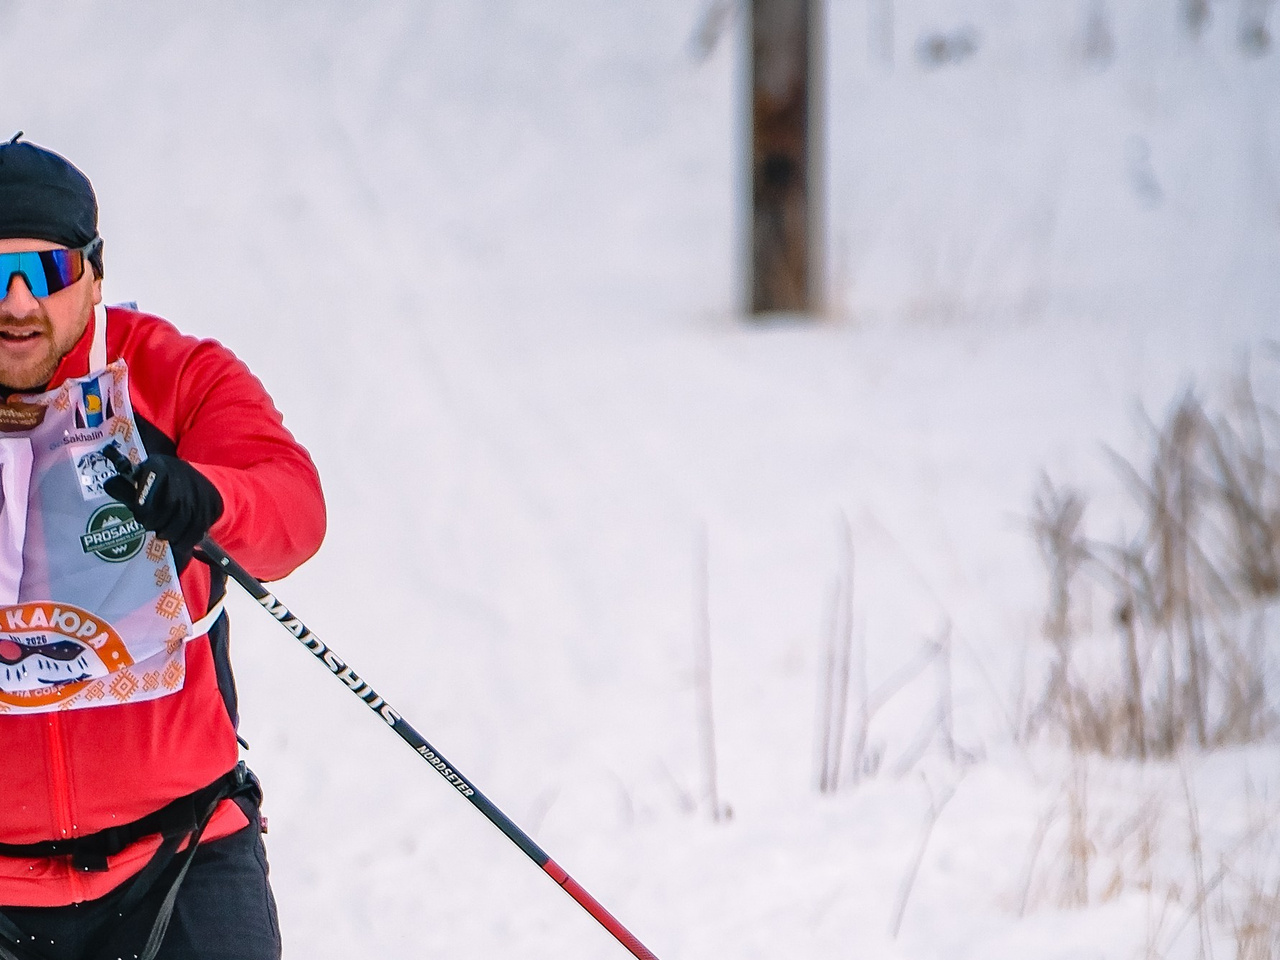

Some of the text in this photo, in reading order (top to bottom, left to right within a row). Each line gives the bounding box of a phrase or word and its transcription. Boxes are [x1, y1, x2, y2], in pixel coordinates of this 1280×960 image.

[5, 606, 110, 650] КАЮРА
[258, 592, 402, 728] MADSHUS
[416, 744, 475, 797] NORDSETER
